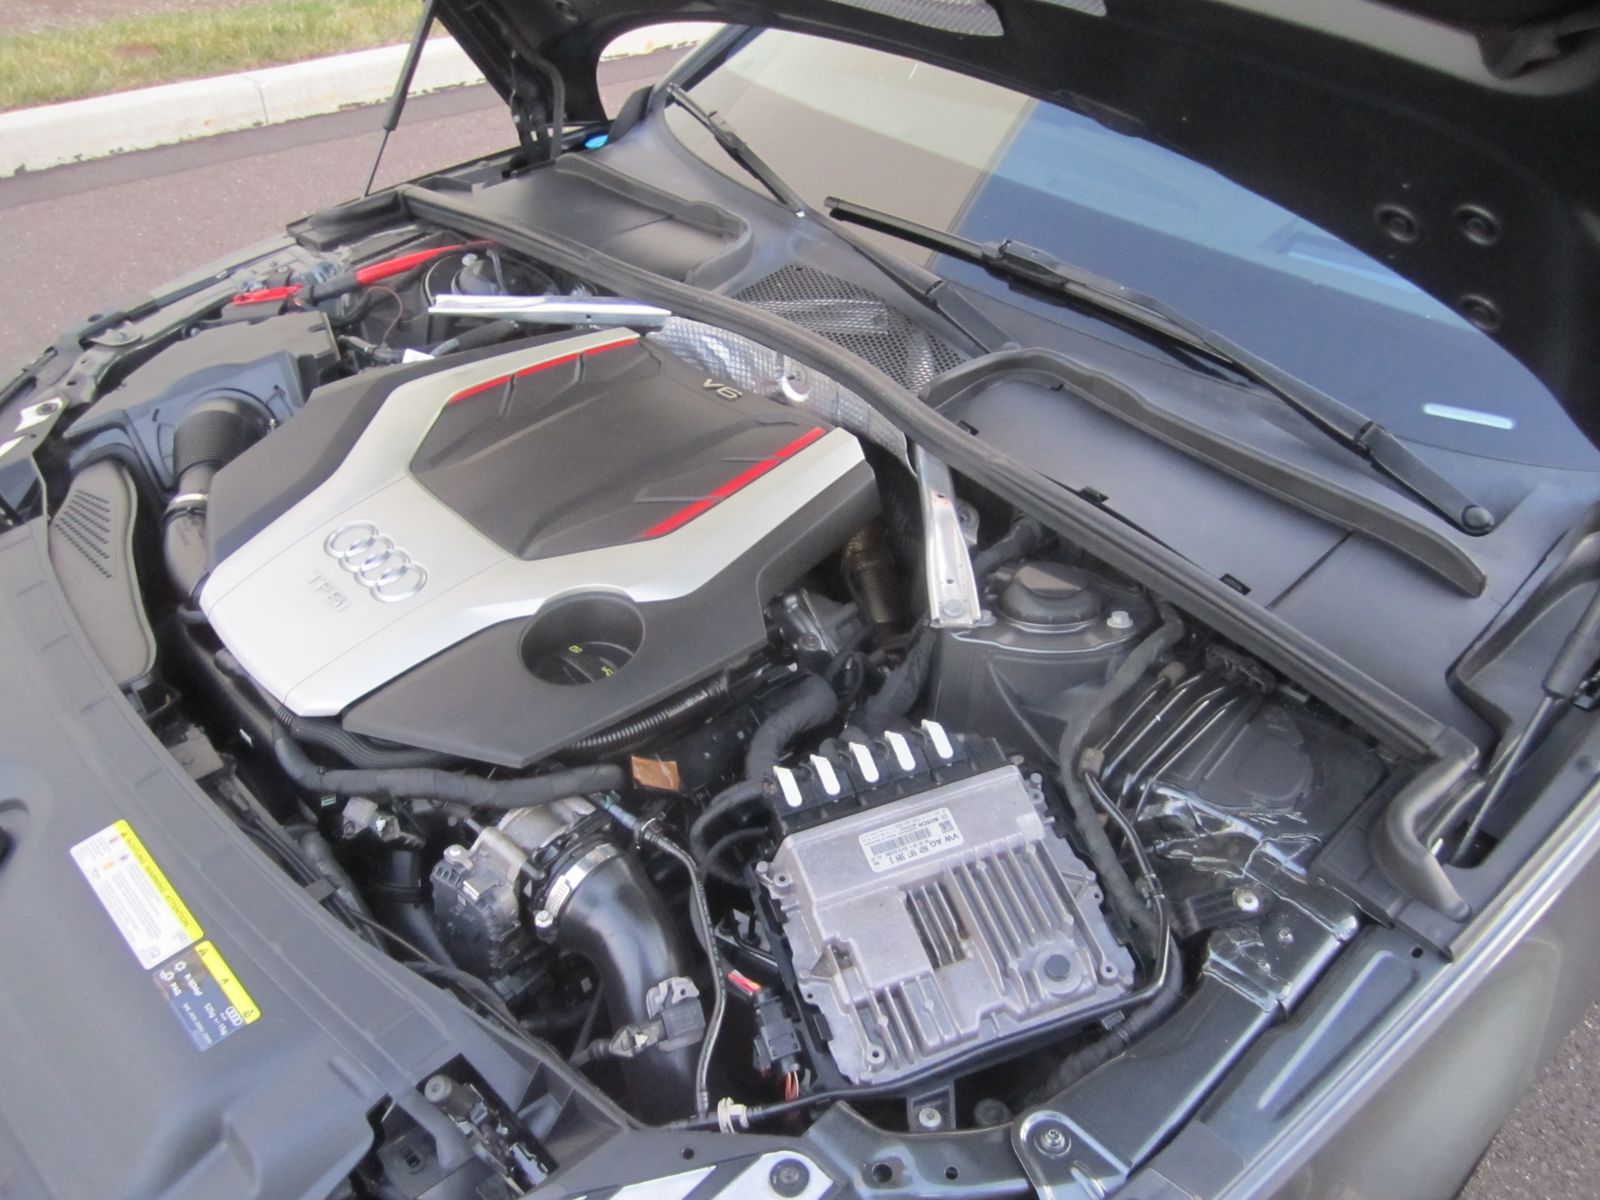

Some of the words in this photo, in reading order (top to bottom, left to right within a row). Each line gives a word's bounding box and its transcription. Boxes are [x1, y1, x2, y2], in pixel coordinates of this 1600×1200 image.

[703, 378, 743, 400] V6
[308, 570, 350, 612] TFSI
[917, 816, 939, 827] BOSCH
[928, 838, 942, 847] AG
[943, 832, 959, 842] VW
[163, 893, 191, 928] ATTENTION
